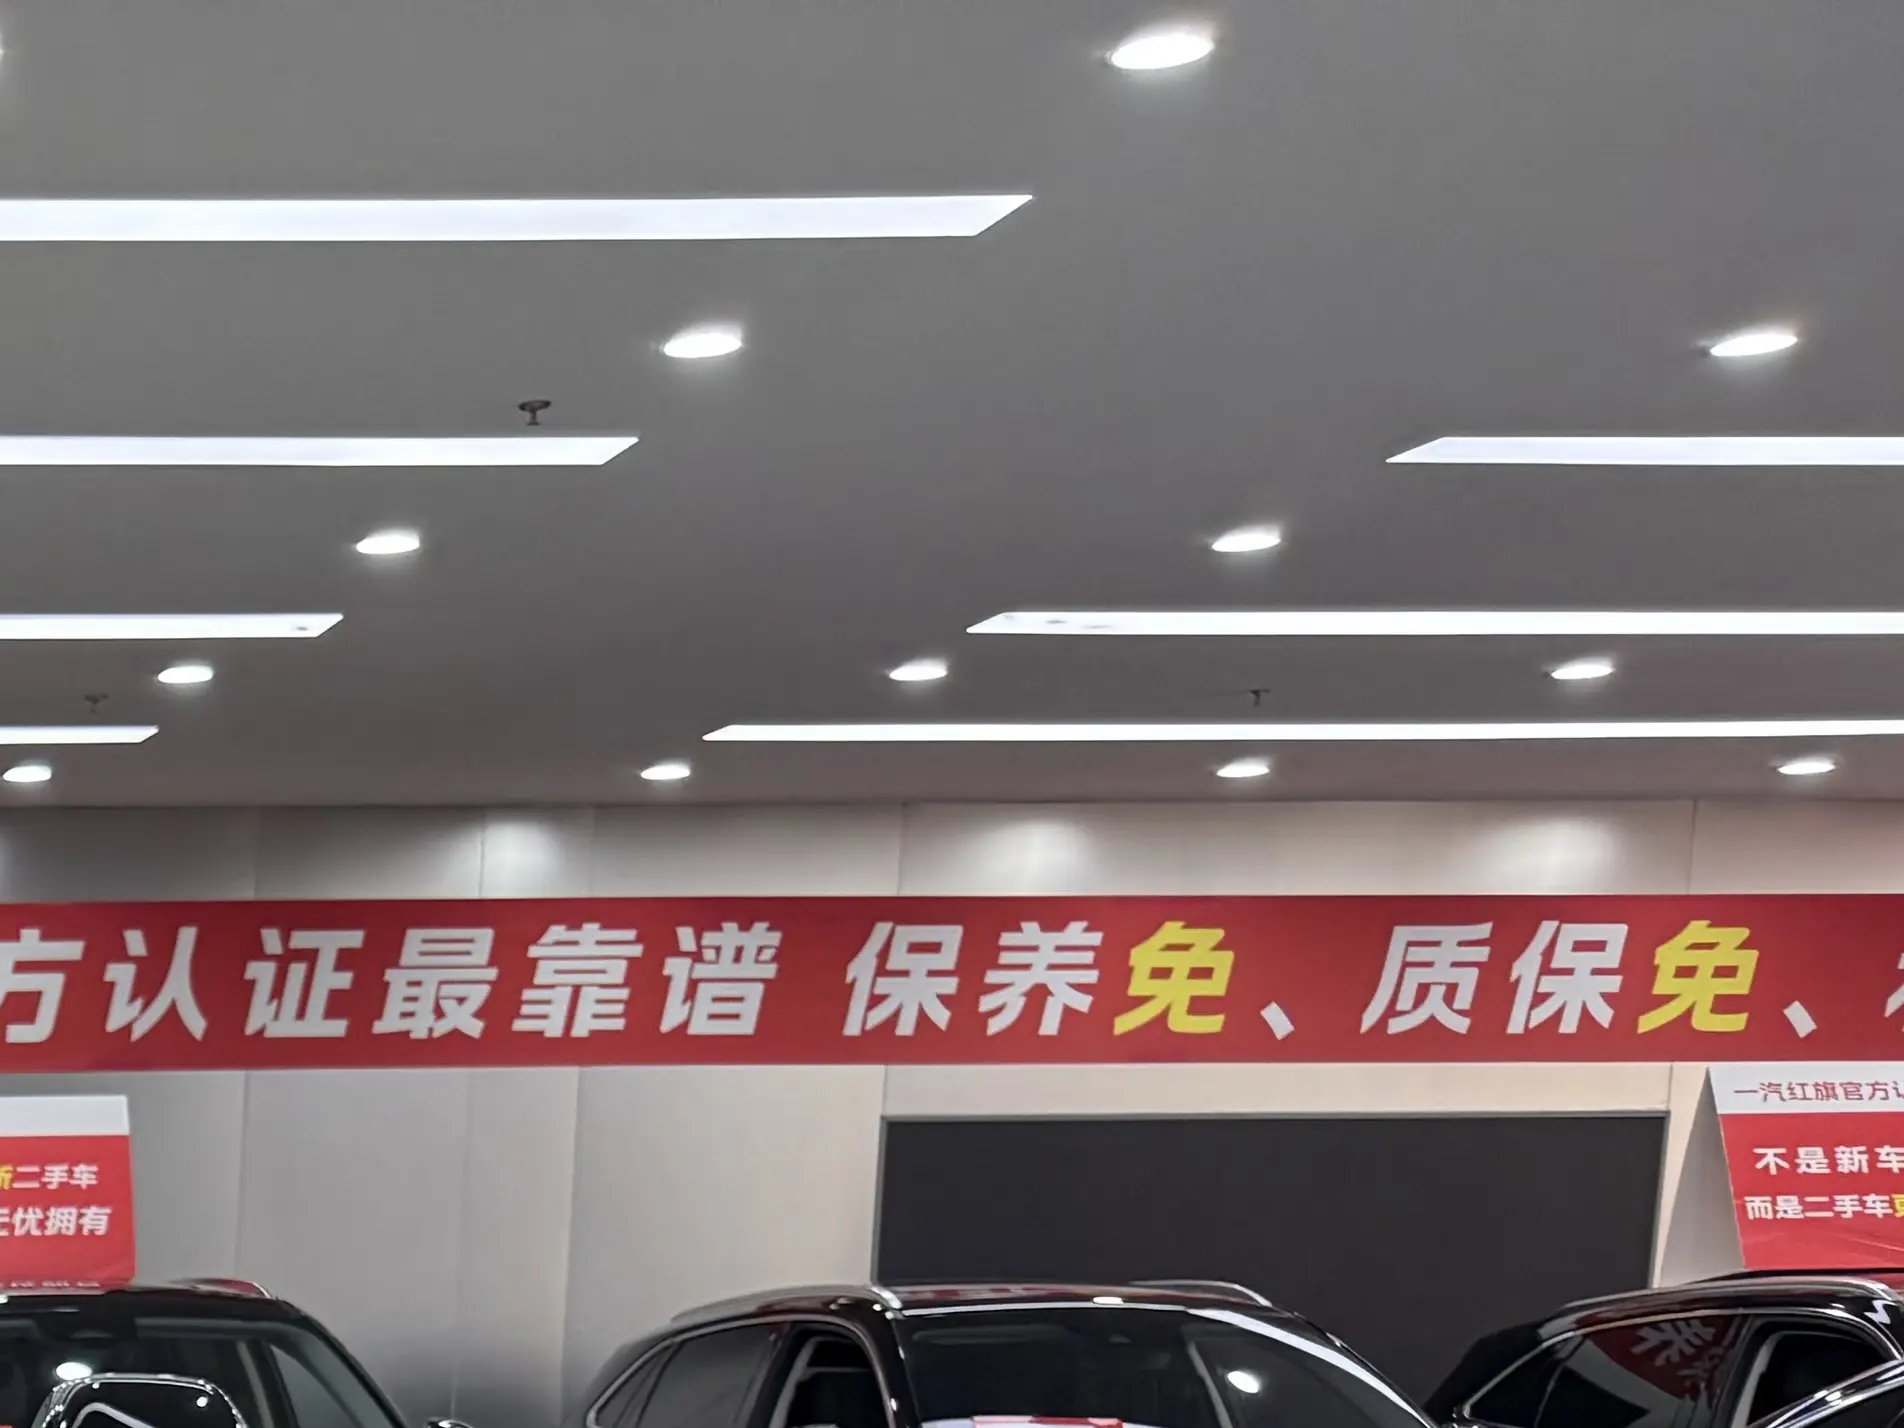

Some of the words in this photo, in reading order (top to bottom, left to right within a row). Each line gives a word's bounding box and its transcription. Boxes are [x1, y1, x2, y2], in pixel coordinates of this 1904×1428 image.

[842, 919, 1904, 1040] 保养免、质保免、
[1752, 1144, 1904, 1176] 不是新车
